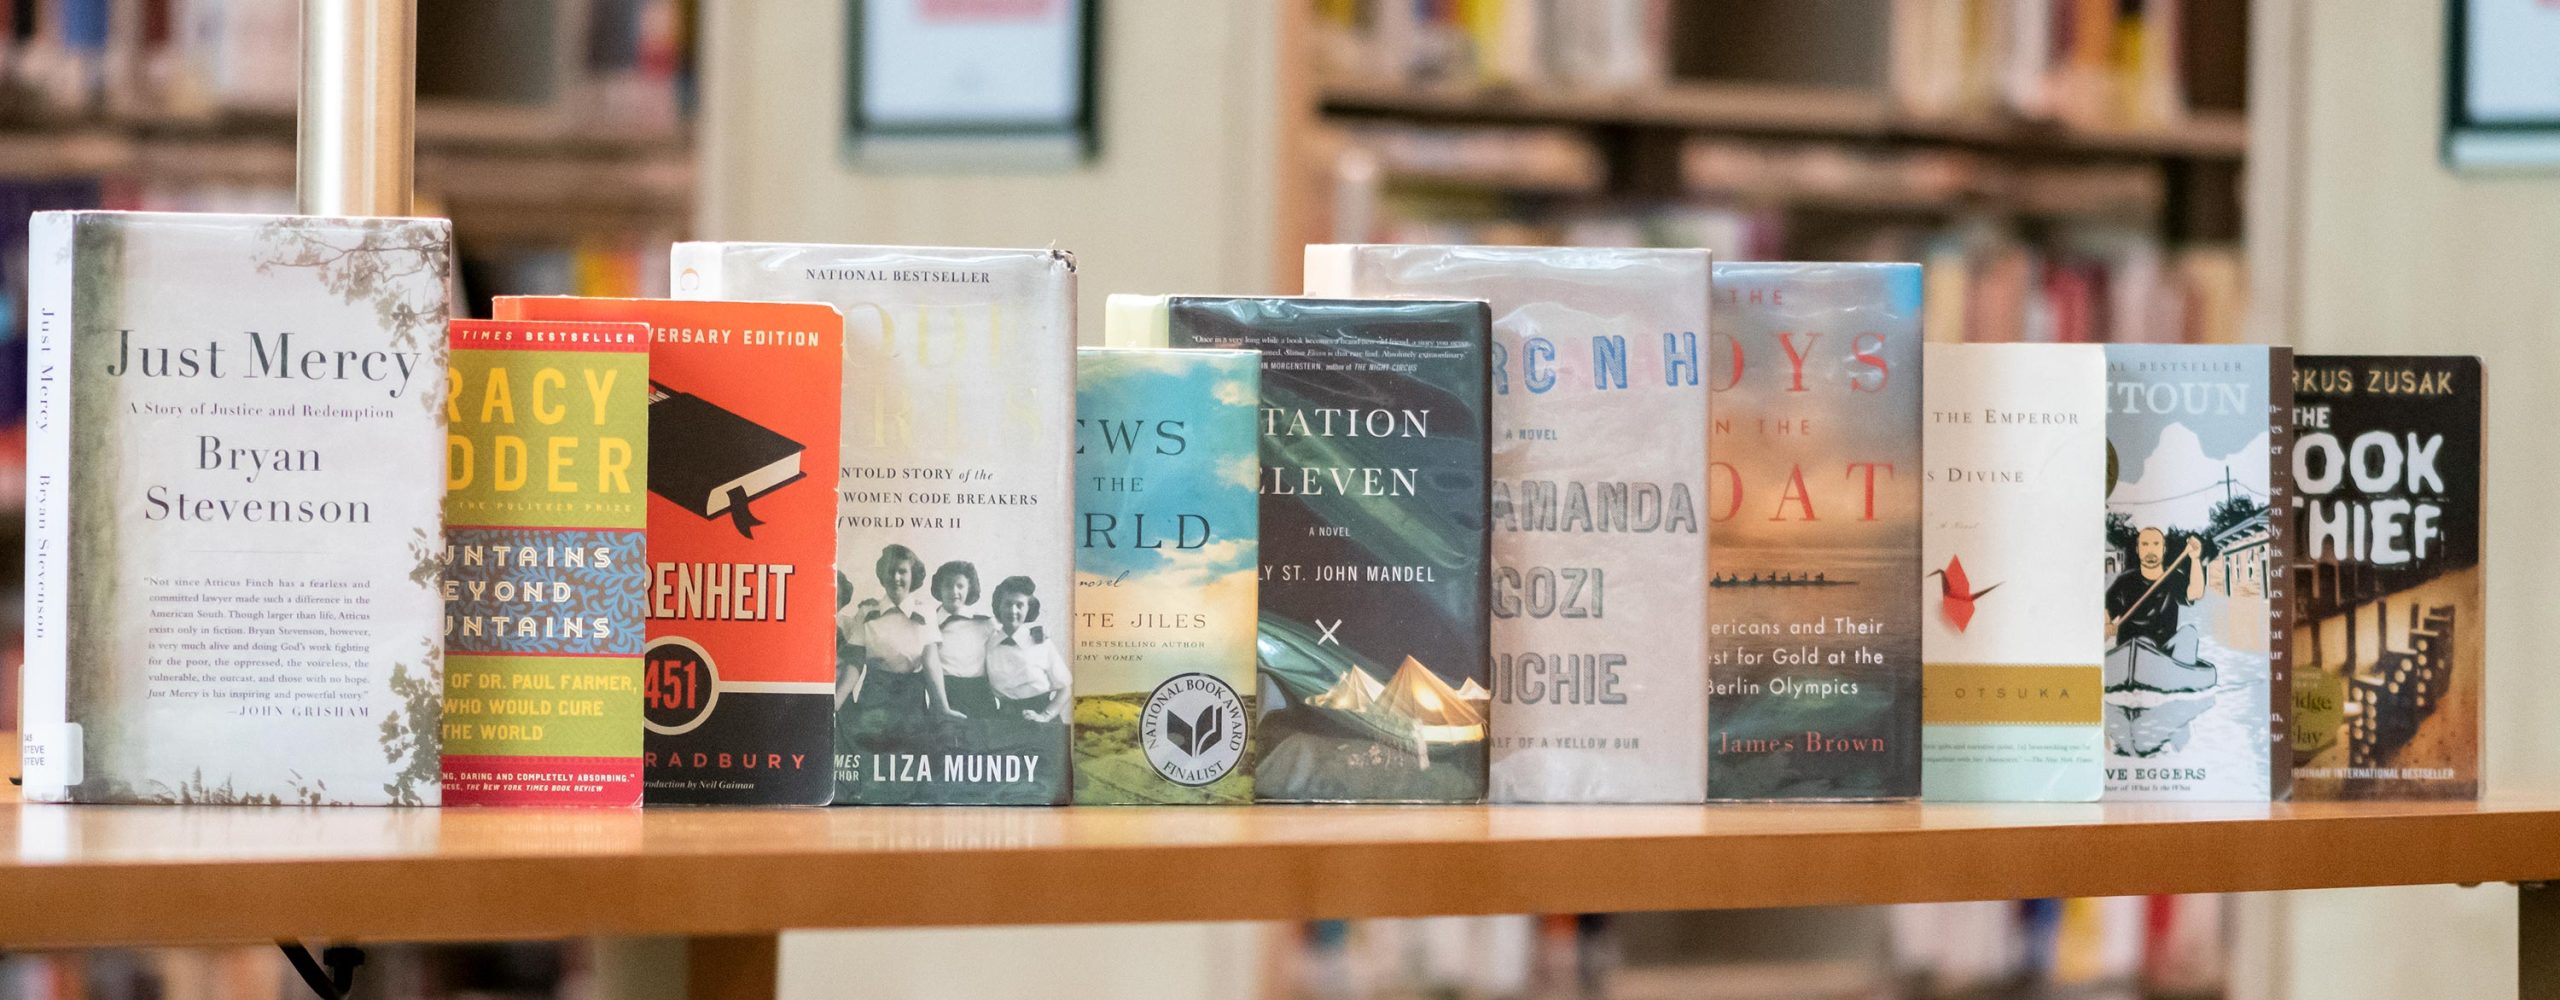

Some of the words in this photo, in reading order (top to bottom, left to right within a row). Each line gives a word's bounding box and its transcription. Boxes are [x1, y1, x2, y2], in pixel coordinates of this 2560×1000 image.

[805, 268, 888, 282] NATIONAL
[892, 269, 991, 284] BESTSELLER
[1729, 289, 1783, 306] THE
[41, 308, 54, 352] Just
[462, 331, 513, 340] TIMES
[526, 332, 635, 344] BESTSELLER
[743, 331, 819, 347] EDITION
[107, 330, 226, 379] Just
[243, 332, 421, 399] Mercy
[2139, 362, 2242, 372] BESTSELLER
[2367, 370, 2453, 395] ZUSAK
[36, 366, 54, 433] Mercy
[127, 402, 138, 414] A
[144, 402, 183, 419] Story
[191, 402, 205, 415] of
[211, 404, 263, 417] Justice
[269, 404, 295, 417] and
[303, 404, 394, 422] Redemption
[1933, 411, 1972, 424] THE
[1985, 409, 2078, 424] EMPEROR
[1506, 429, 1512, 440] A
[1519, 429, 1558, 440] NOVEL
[1757, 420, 1810, 435] THE
[196, 435, 323, 483] Bryan
[2292, 430, 2444, 494] OOK
[902, 467, 954, 481] STORY
[959, 468, 971, 482] of
[971, 468, 993, 481] the
[1259, 467, 1419, 496] LEVEN
[1948, 467, 2024, 482] DIVINE
[1093, 477, 1144, 492] THE
[38, 475, 51, 529] Bryan
[145, 486, 371, 524] Stevenson
[843, 492, 902, 505] WOMEN
[909, 492, 951, 505] CODE
[957, 493, 1039, 506] BREAKERS
[847, 516, 905, 529] WORLD
[911, 517, 945, 529] WAR
[949, 518, 961, 529] II
[1083, 513, 1210, 549] RLD
[1309, 527, 1315, 536] A
[1319, 527, 1351, 537] NOVEL
[1079, 570, 1130, 588] novel
[1282, 566, 1305, 581] ST.
[1315, 566, 1357, 582] JOHN
[1367, 566, 1435, 582] MANDEL
[36, 538, 49, 639] Stevenson
[175, 578, 200, 586] since
[204, 578, 240, 587] Atticus
[246, 578, 274, 587] Finch
[279, 579, 295, 588] has
[309, 579, 347, 588] fearless
[352, 580, 370, 588] and
[149, 594, 199, 602] committed
[202, 594, 233, 605] lawyer
[236, 594, 260, 603] made
[264, 595, 283, 603] such
[295, 595, 339, 604] difference
[344, 595, 352, 604] in
[356, 596, 370, 604] the
[1131, 613, 1206, 629] JILES
[1711, 619, 1780, 634] ericans
[1790, 616, 1825, 634] and
[1835, 617, 1883, 634] Their
[1081, 640, 1156, 648] BESTSELLING
[1737, 646, 1763, 664] for
[1773, 647, 1818, 665] Gold
[1828, 649, 1845, 664] at
[1855, 647, 1883, 664] the
[452, 674, 470, 688] OF
[479, 674, 506, 689] DR.
[513, 675, 555, 690] PAUL
[561, 675, 637, 695] FARMER,
[644, 660, 697, 709] 451
[1769, 677, 1858, 699] Olympics
[1955, 688, 2070, 699] OTSUKA
[292, 707, 369, 717] GRISHAM
[443, 699, 480, 714] WHO
[490, 700, 551, 715] WOULD
[558, 701, 604, 716] CURE
[1146, 682, 1184, 750] NATIONAL
[1186, 679, 1226, 699] BOOK
[1223, 699, 1242, 751] AWARD
[480, 725, 543, 740] WORLD
[1556, 737, 1607, 749] YELLOW
[1718, 732, 1794, 753] James
[1807, 732, 1885, 753] Brown
[645, 752, 805, 769] RADBURY
[873, 754, 932, 782] LIZA
[944, 755, 1039, 782] MUNDY
[461, 773, 492, 781] DARING
[496, 773, 514, 781] AND
[517, 773, 573, 781] COMPLETELY
[1163, 760, 1224, 781] FINALIST
[2135, 768, 2206, 780] EGGERS
[2334, 768, 2399, 779] INTERNATIONAL
[2402, 768, 2454, 779] BESTSELLER
[687, 781, 697, 790] by
[699, 781, 717, 789] Neil
[719, 782, 754, 790] Gaiman
